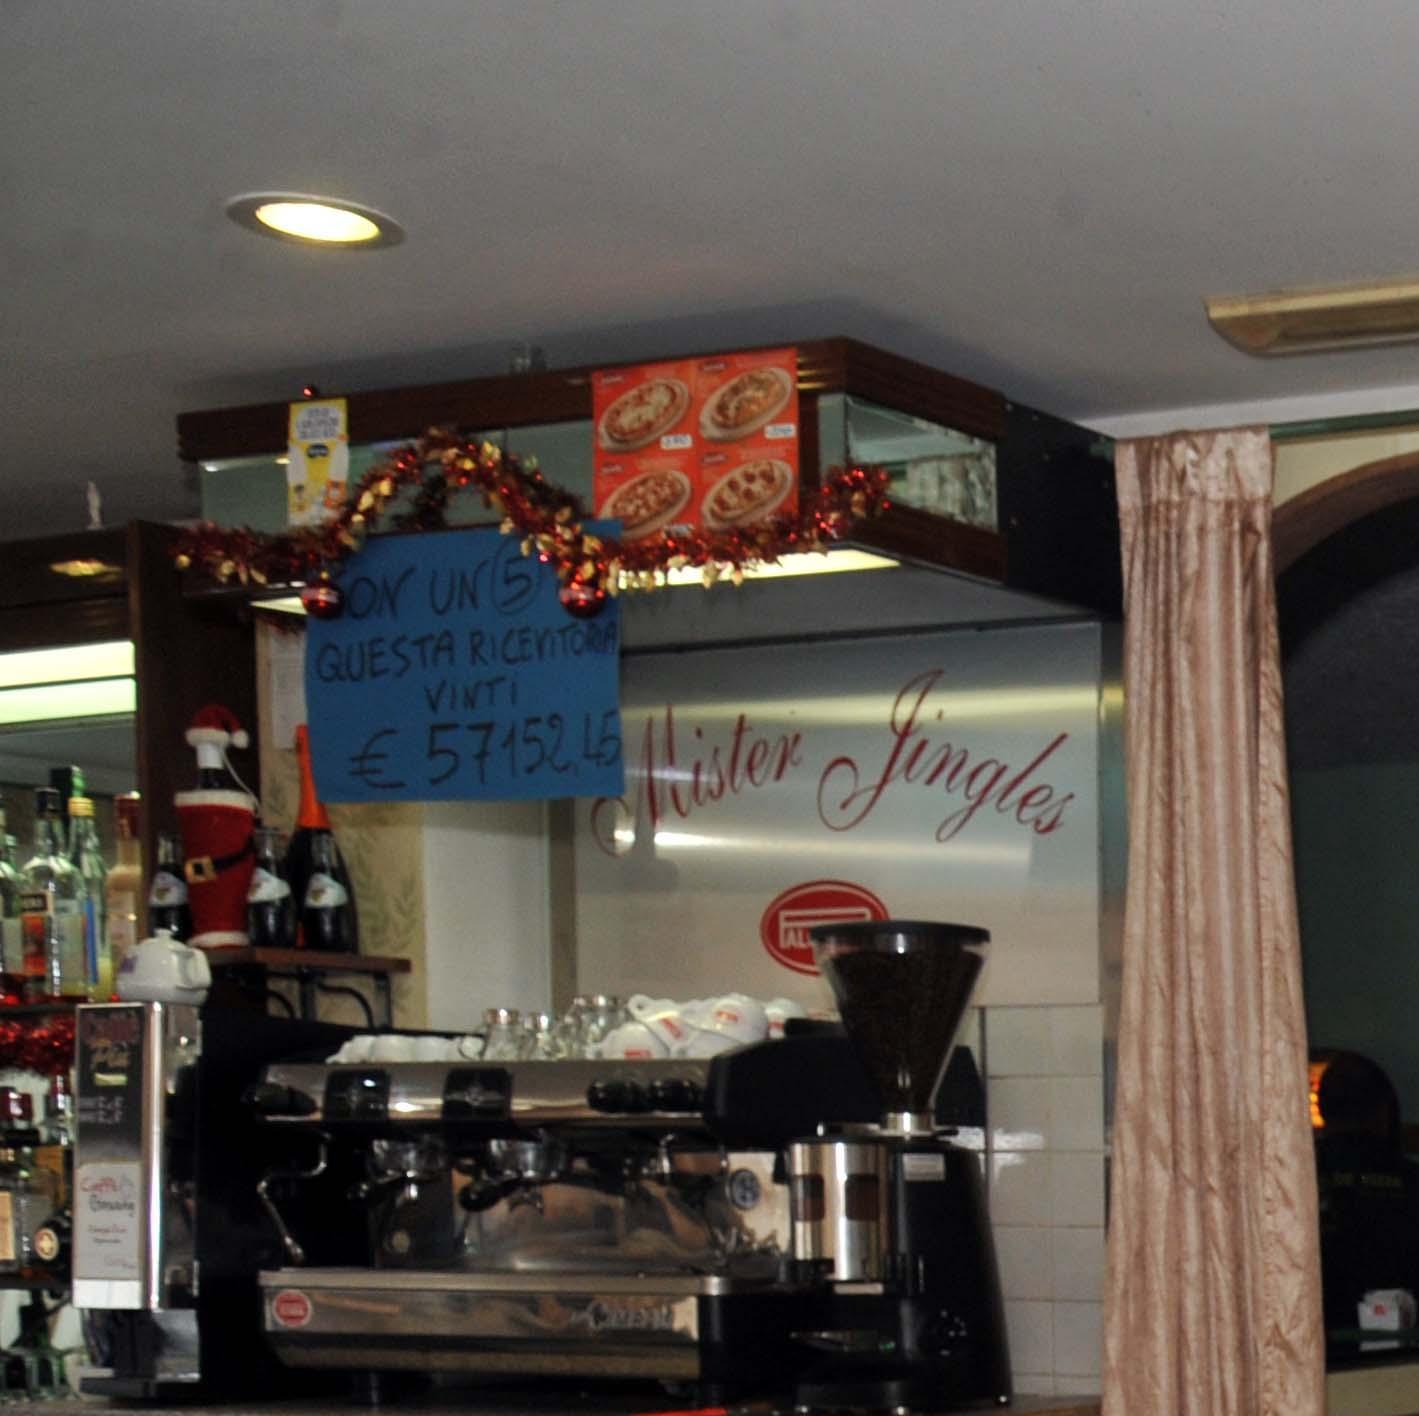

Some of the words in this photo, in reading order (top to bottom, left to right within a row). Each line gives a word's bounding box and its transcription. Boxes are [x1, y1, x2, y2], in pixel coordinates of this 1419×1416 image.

[343, 566, 416, 620] ON
[315, 629, 456, 683] QUESTA
[425, 677, 518, 714] VINTI
[350, 728, 406, 789] €
[590, 703, 802, 858] Mister
[817, 668, 1075, 843] Jingles
